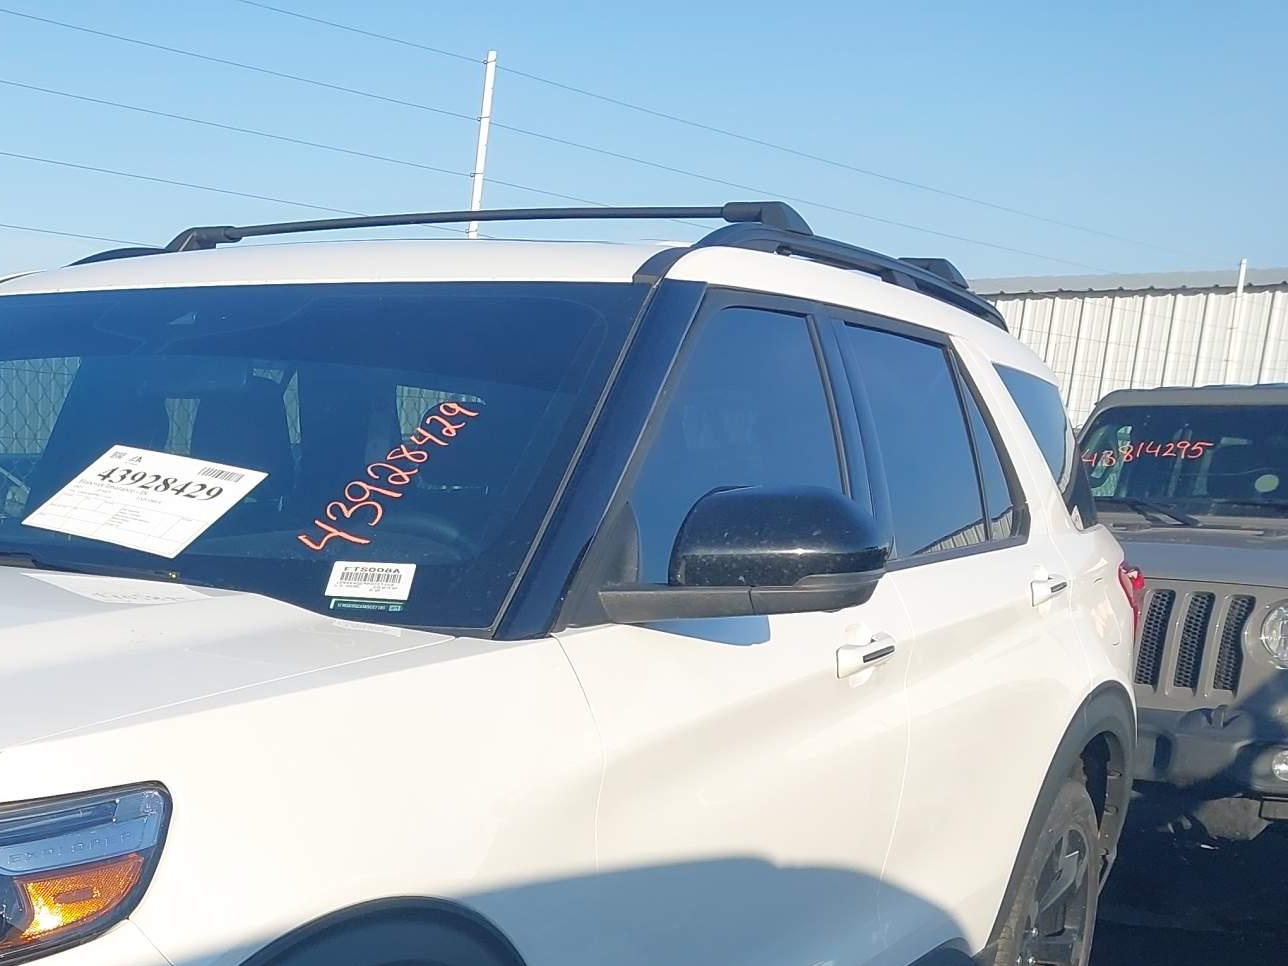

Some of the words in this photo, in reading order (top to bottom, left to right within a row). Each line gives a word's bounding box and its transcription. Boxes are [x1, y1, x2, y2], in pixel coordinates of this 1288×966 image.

[1081, 440, 1215, 467] 43814295
[97, 467, 224, 501] 43928429
[297, 400, 479, 550] 43928429
